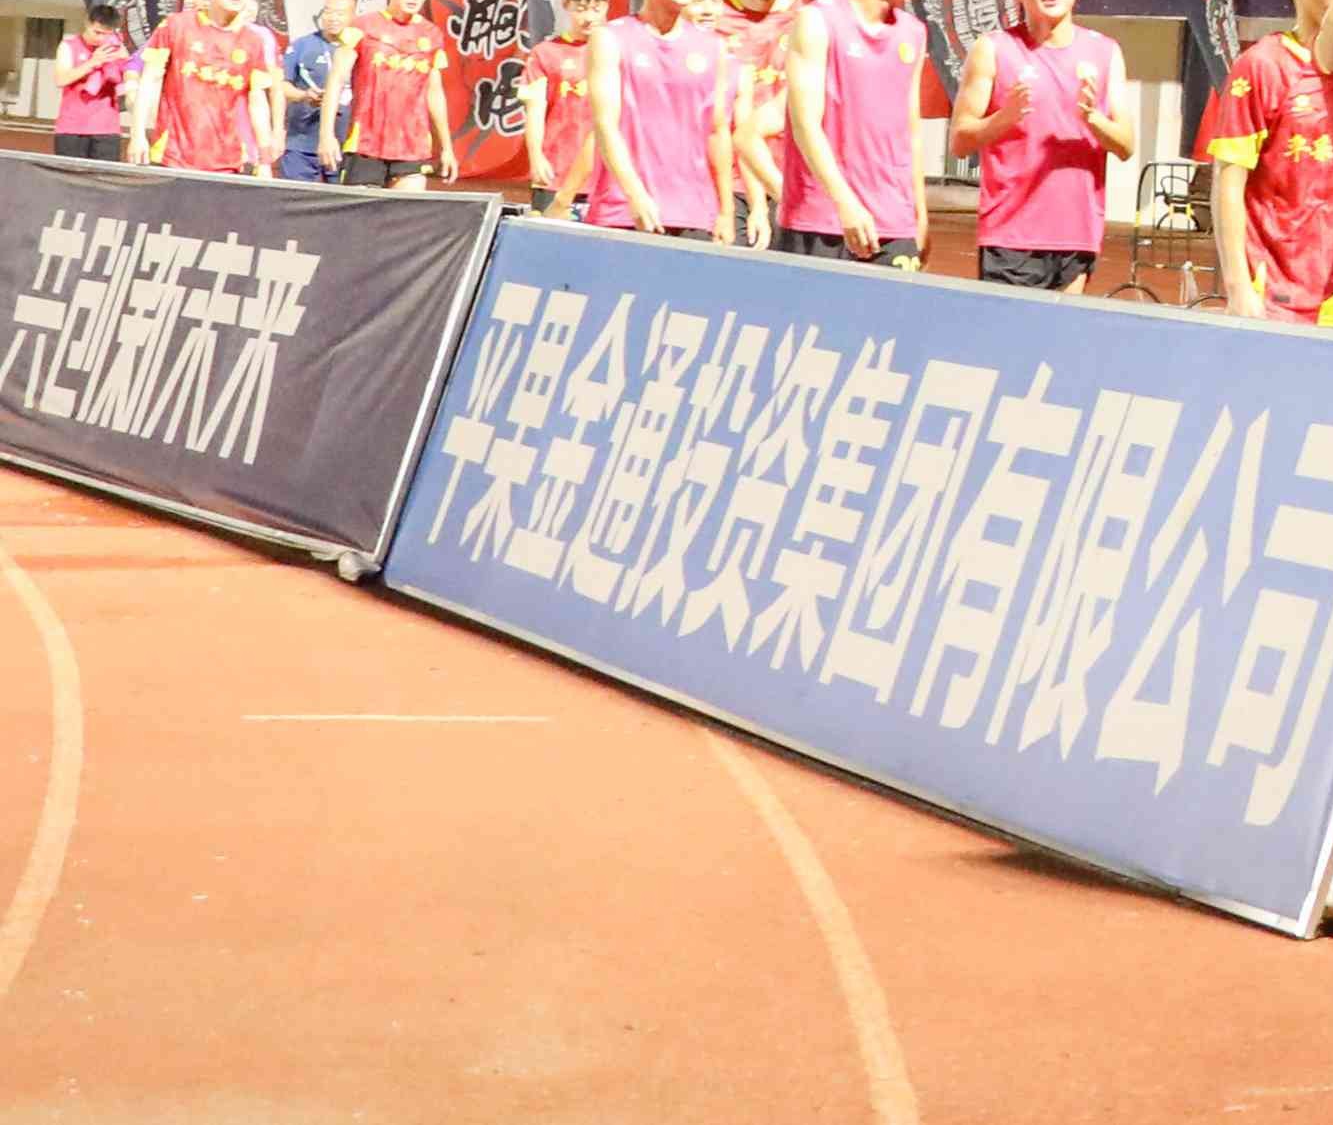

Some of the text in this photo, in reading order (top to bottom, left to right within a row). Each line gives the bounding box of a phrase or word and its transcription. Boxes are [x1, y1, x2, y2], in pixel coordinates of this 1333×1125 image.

[0, 209, 321, 465] 共创新未来
